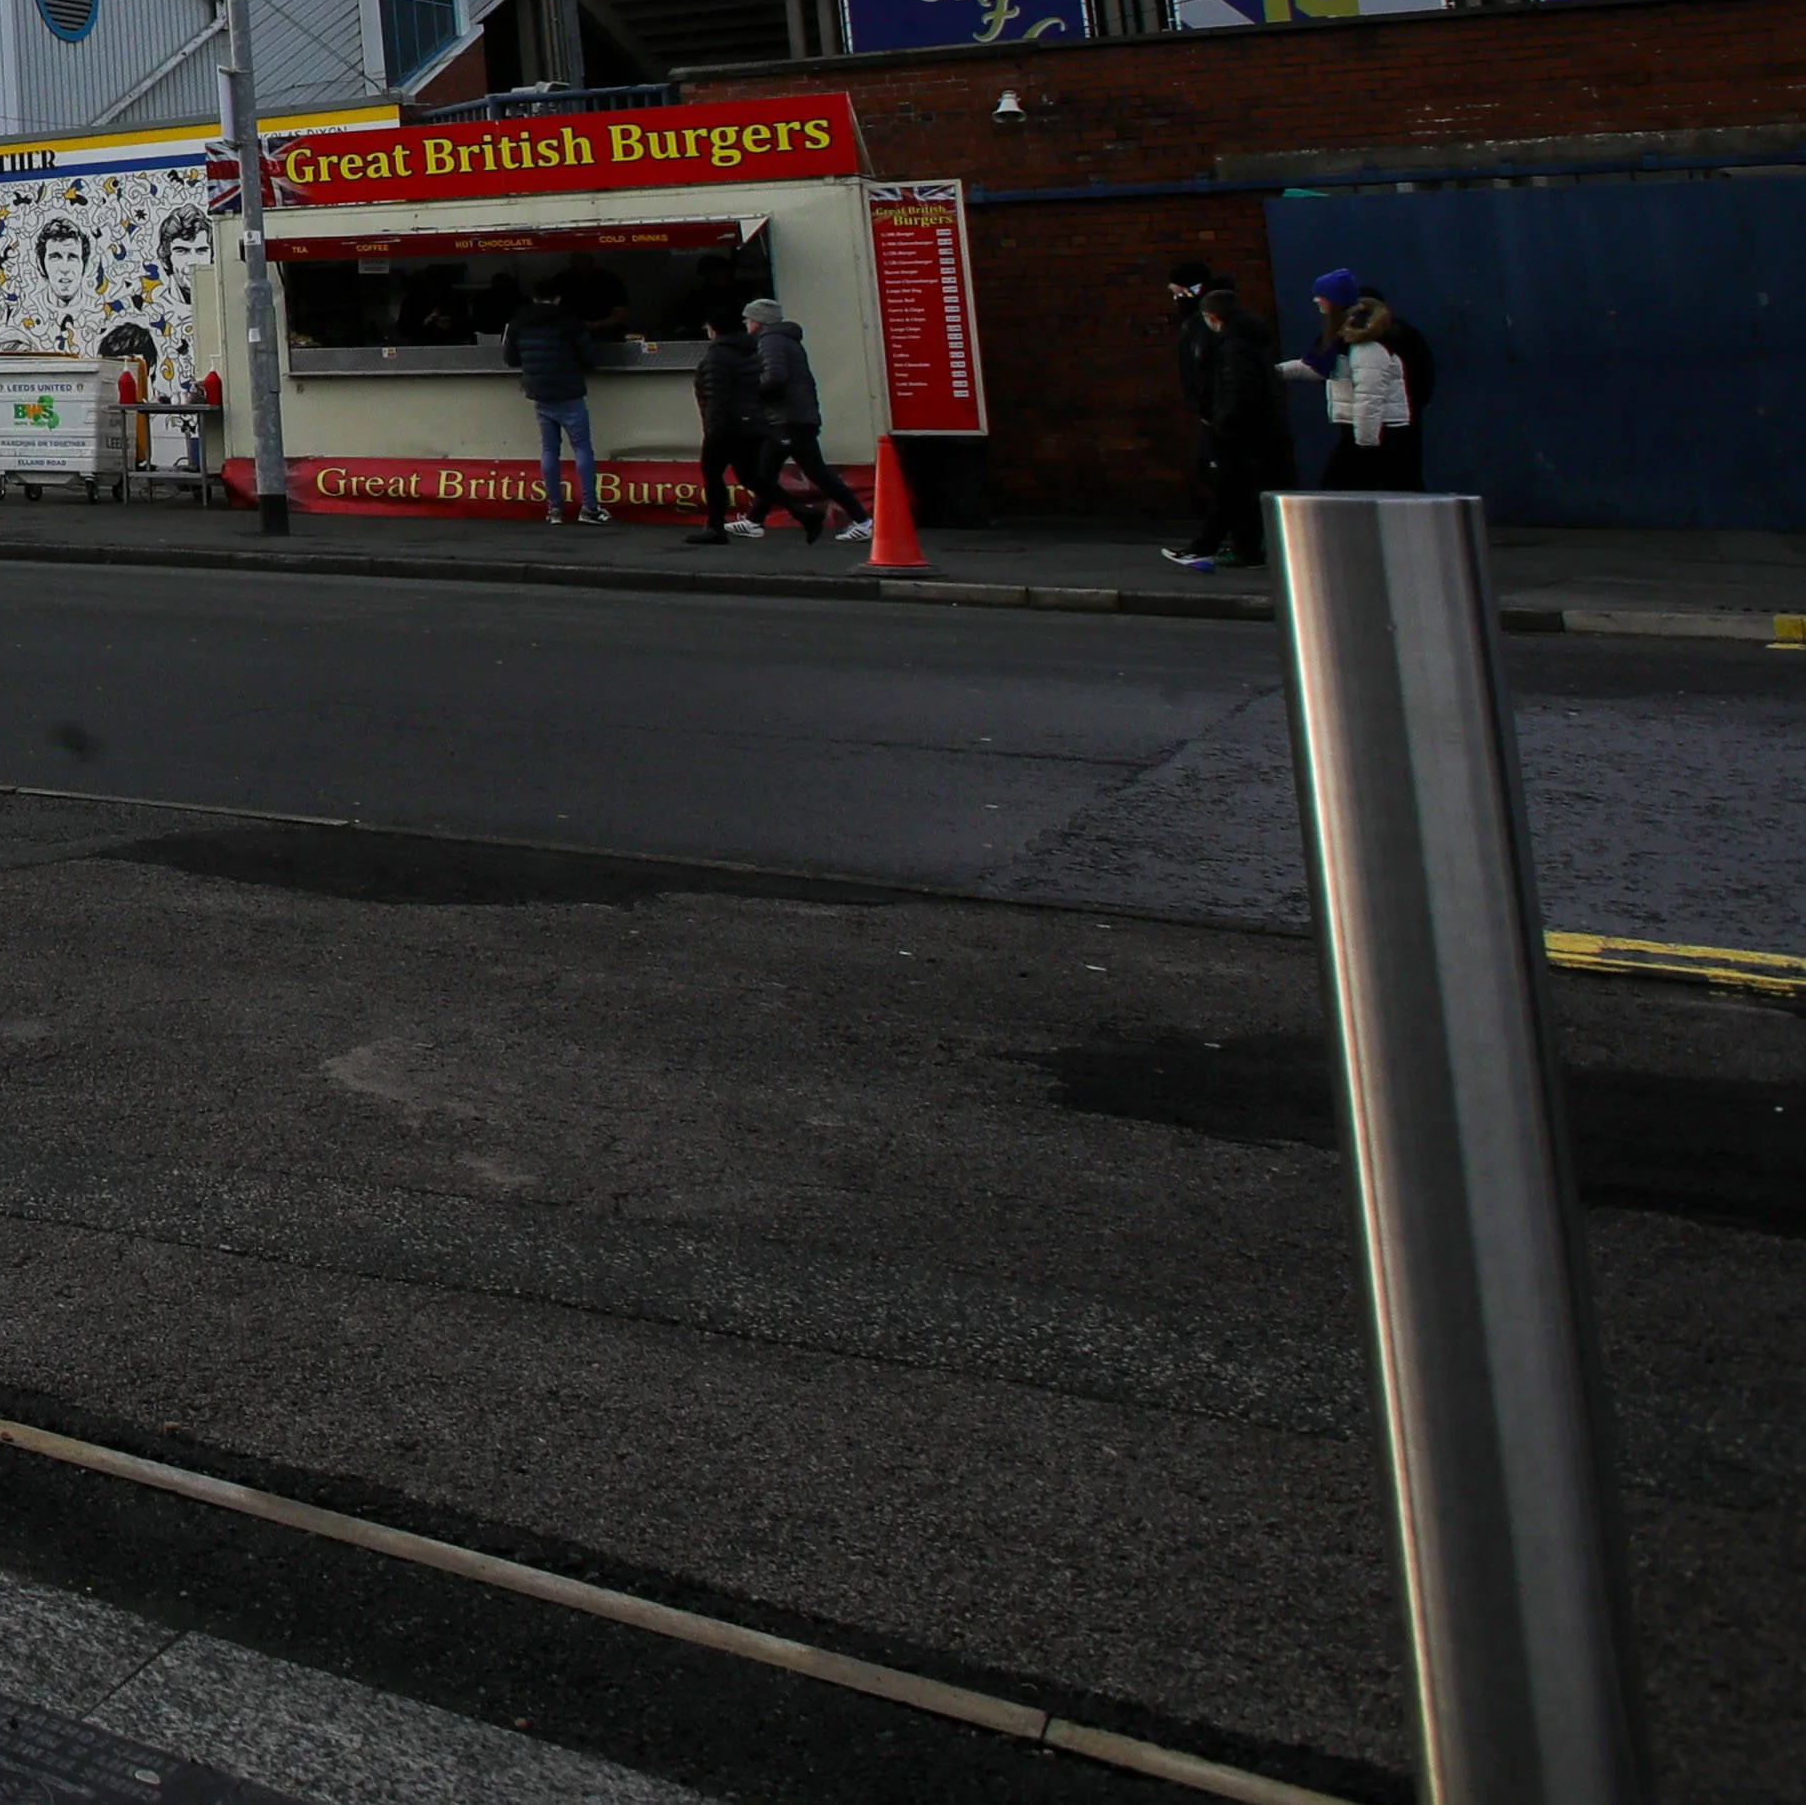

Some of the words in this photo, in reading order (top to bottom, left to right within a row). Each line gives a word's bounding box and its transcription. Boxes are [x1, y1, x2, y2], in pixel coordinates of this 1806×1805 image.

[286, 138, 413, 186] Great
[423, 125, 594, 177] British
[608, 115, 832, 168] Burgers
[893, 215, 954, 227] Burgers
[356, 243, 389, 252] COFFEE
[455, 240, 474, 249] HOT
[477, 237, 533, 248] CHOCOLATE
[599, 235, 625, 243] COLD
[631, 233, 669, 242] DRINKS
[7, 383, 35, 392] LEEDS
[38, 383, 73, 392] UNITED
[316, 467, 421, 499] Great
